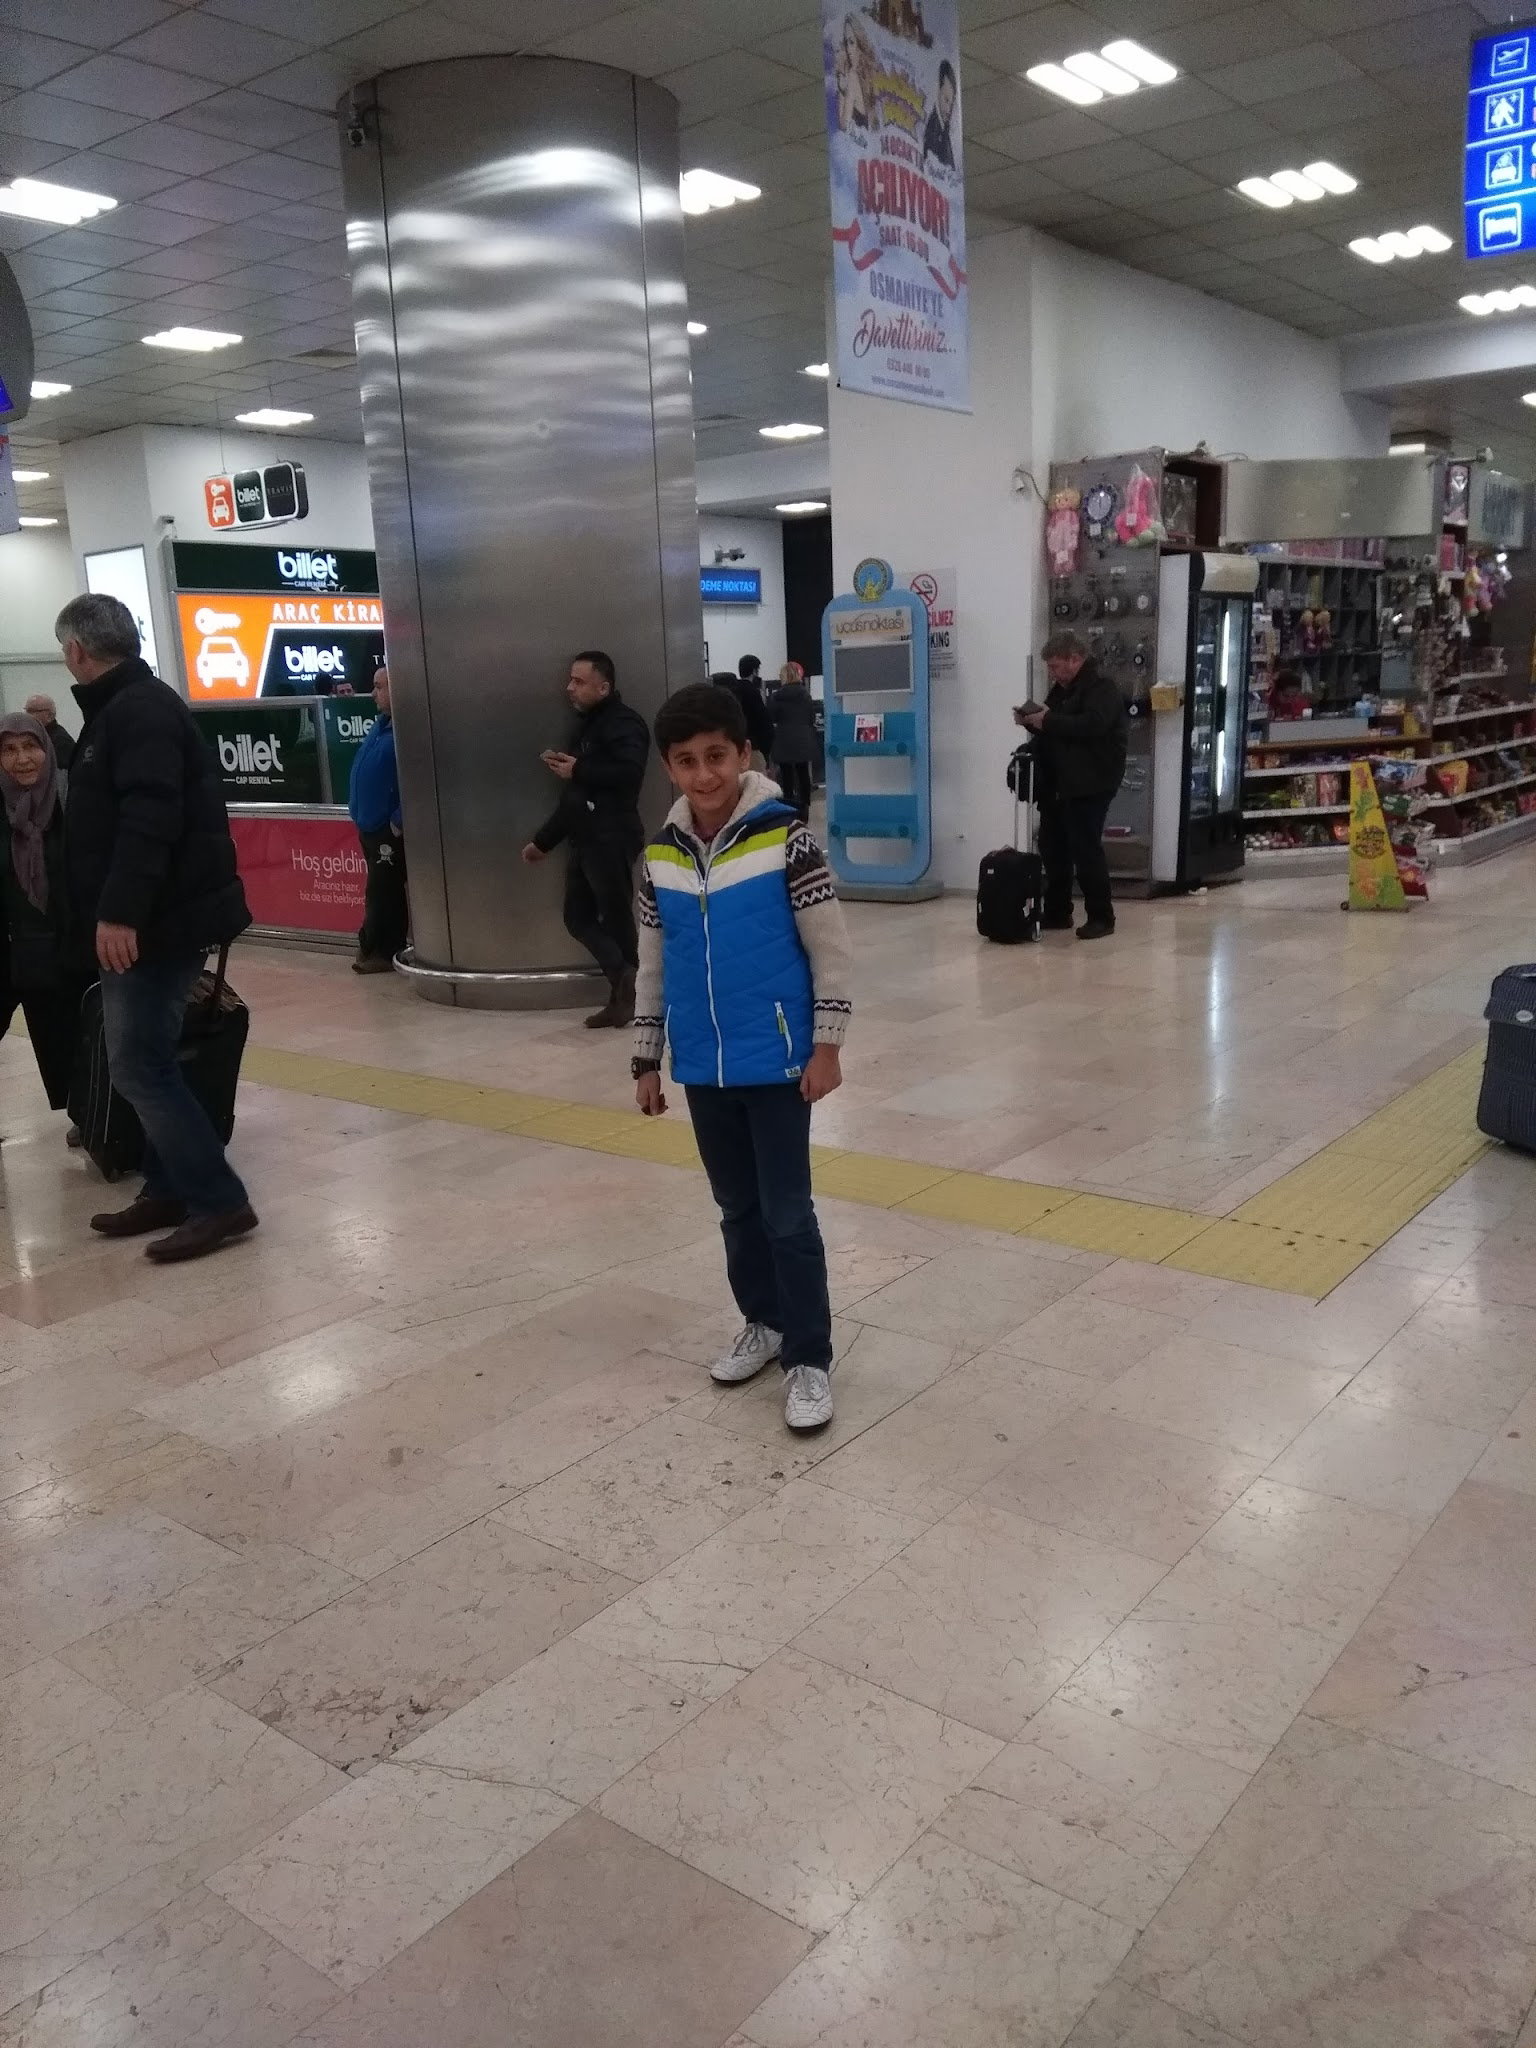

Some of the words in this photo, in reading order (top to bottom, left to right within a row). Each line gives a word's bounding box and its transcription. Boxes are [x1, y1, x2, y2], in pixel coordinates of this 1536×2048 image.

[237, 486, 260, 503] billet
[277, 551, 339, 580] billet
[273, 603, 320, 623] ARAÇ
[333, 601, 380, 621] KİRA
[284, 646, 345, 673] billet
[217, 733, 284, 772] billet
[249, 776, 271, 785] RENTAL
[291, 848, 320, 877] Hoş
